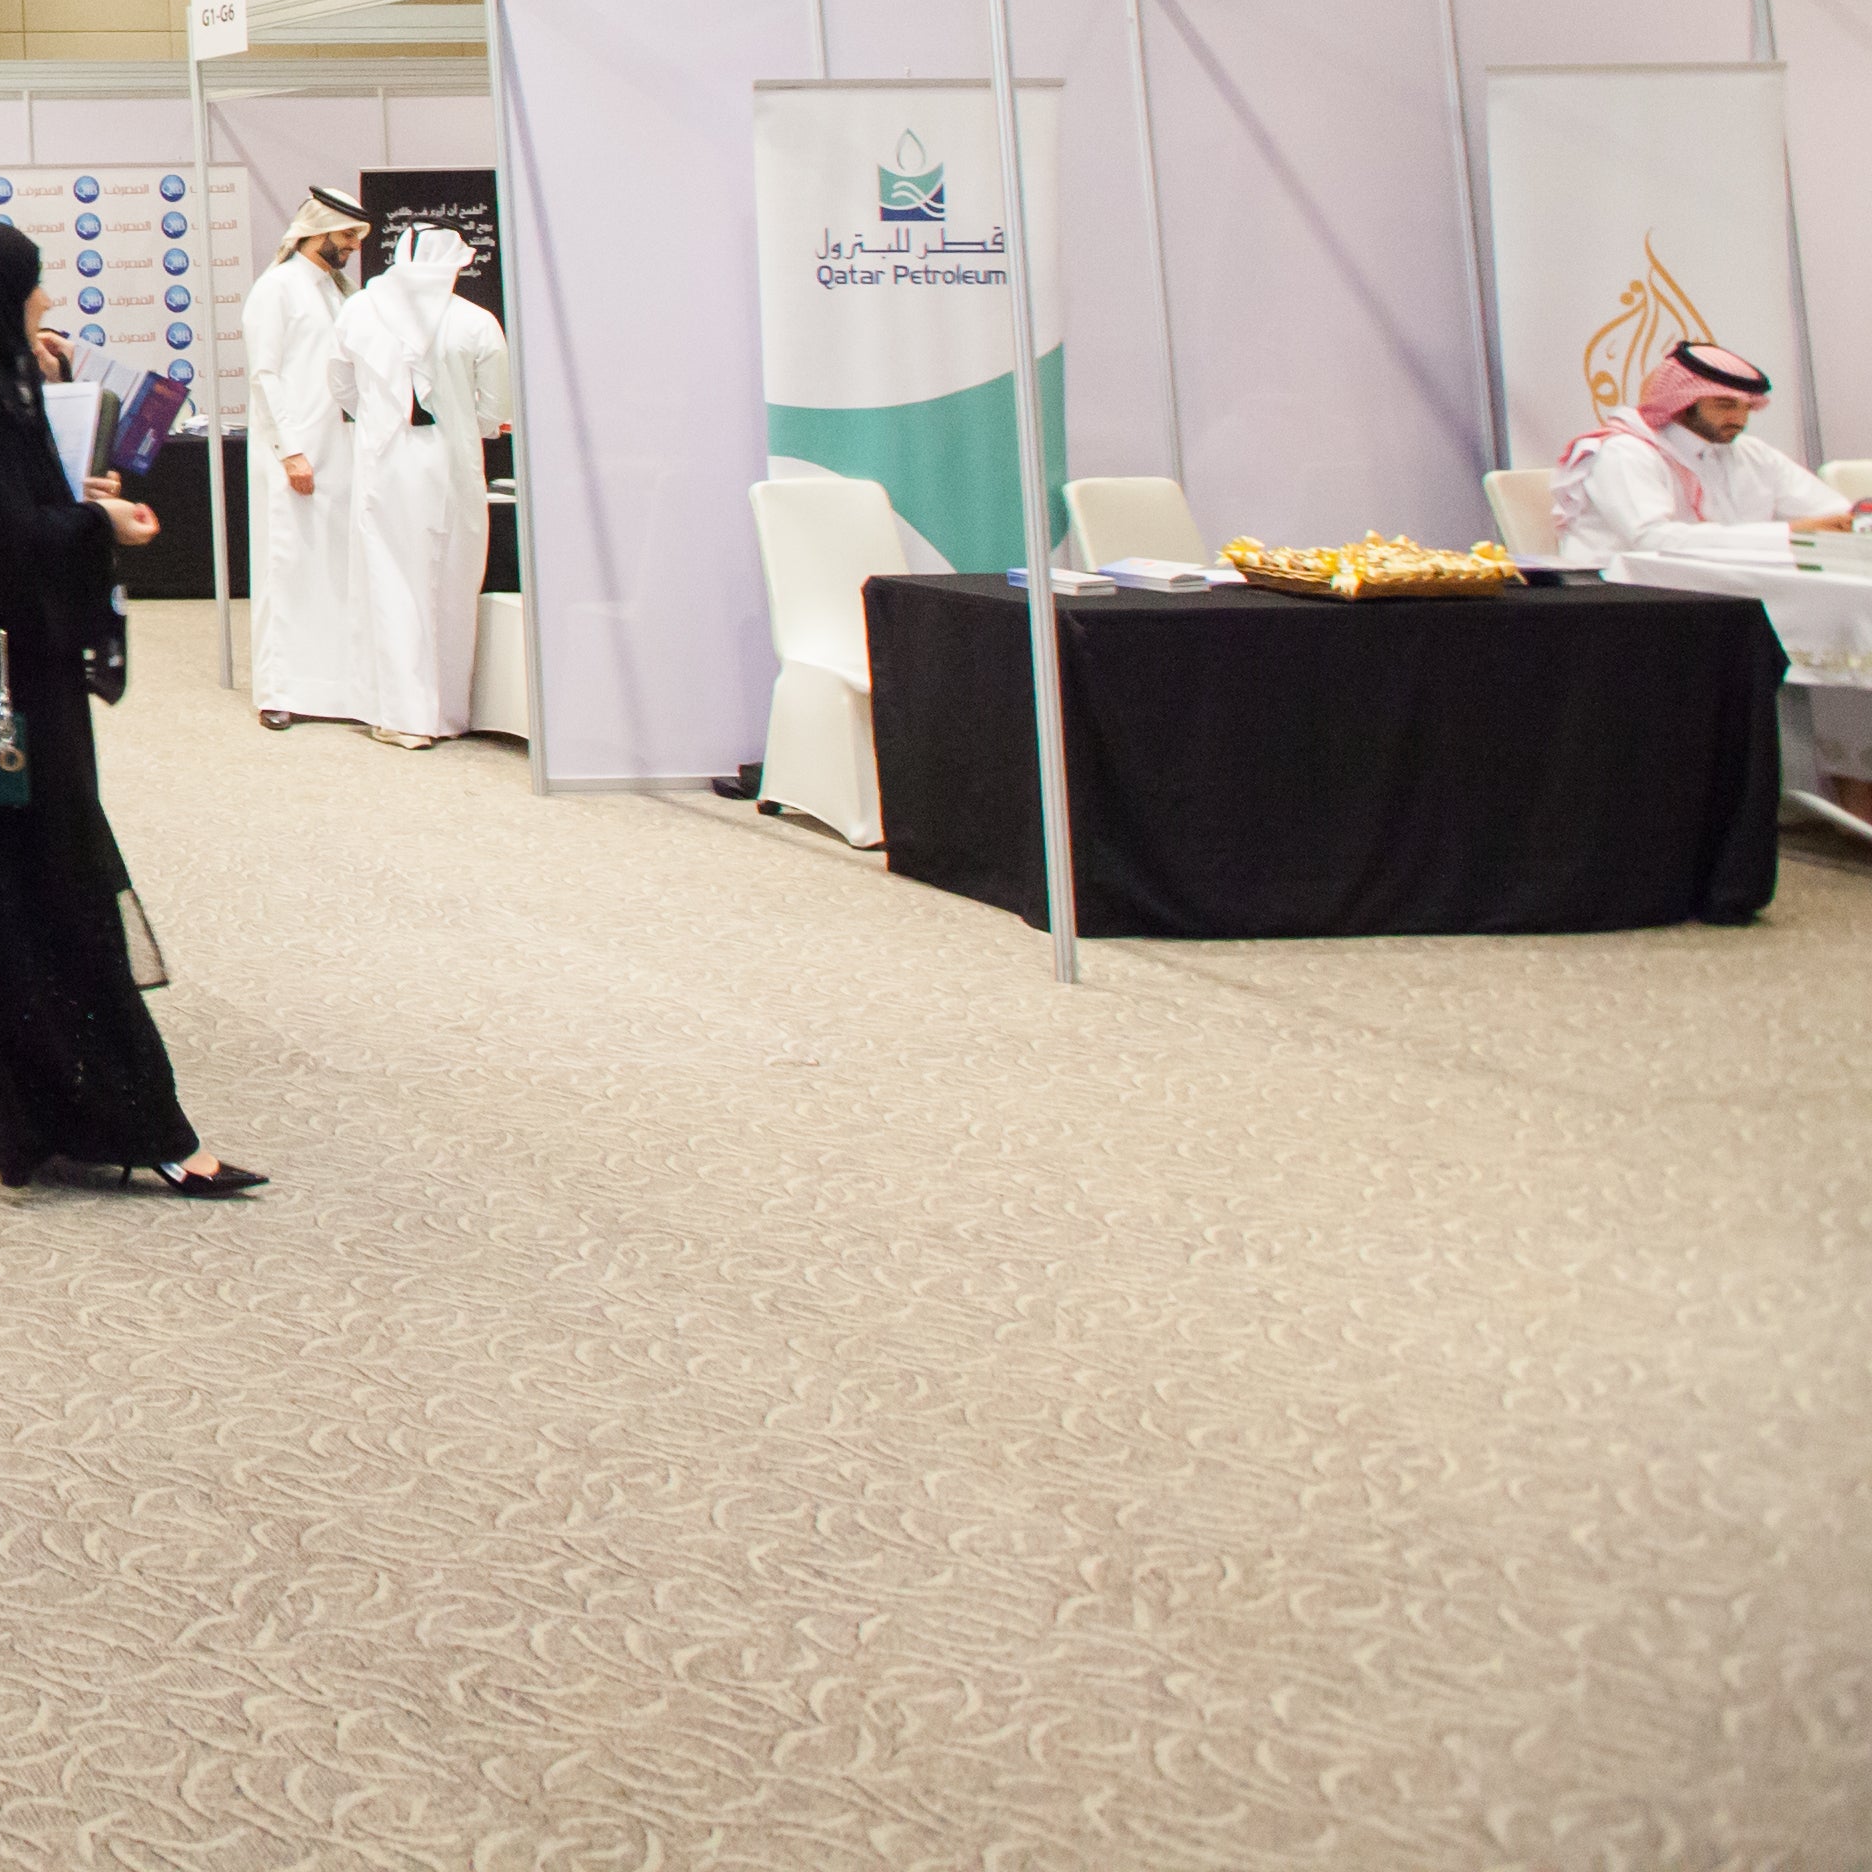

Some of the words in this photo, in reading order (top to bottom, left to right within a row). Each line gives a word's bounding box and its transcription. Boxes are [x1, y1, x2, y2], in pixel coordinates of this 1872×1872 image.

[202, 3, 235, 27] G1-G6
[103, 184, 149, 197] المصرف
[105, 221, 151, 234] المصرف
[815, 227, 910, 259] للبترول
[916, 227, 1005, 259] قطر
[107, 258, 153, 271] المصرف
[816, 264, 885, 289] Qatar
[893, 264, 1007, 285] Petroleum
[108, 295, 154, 307] المصرف
[110, 332, 156, 344] المصرف
